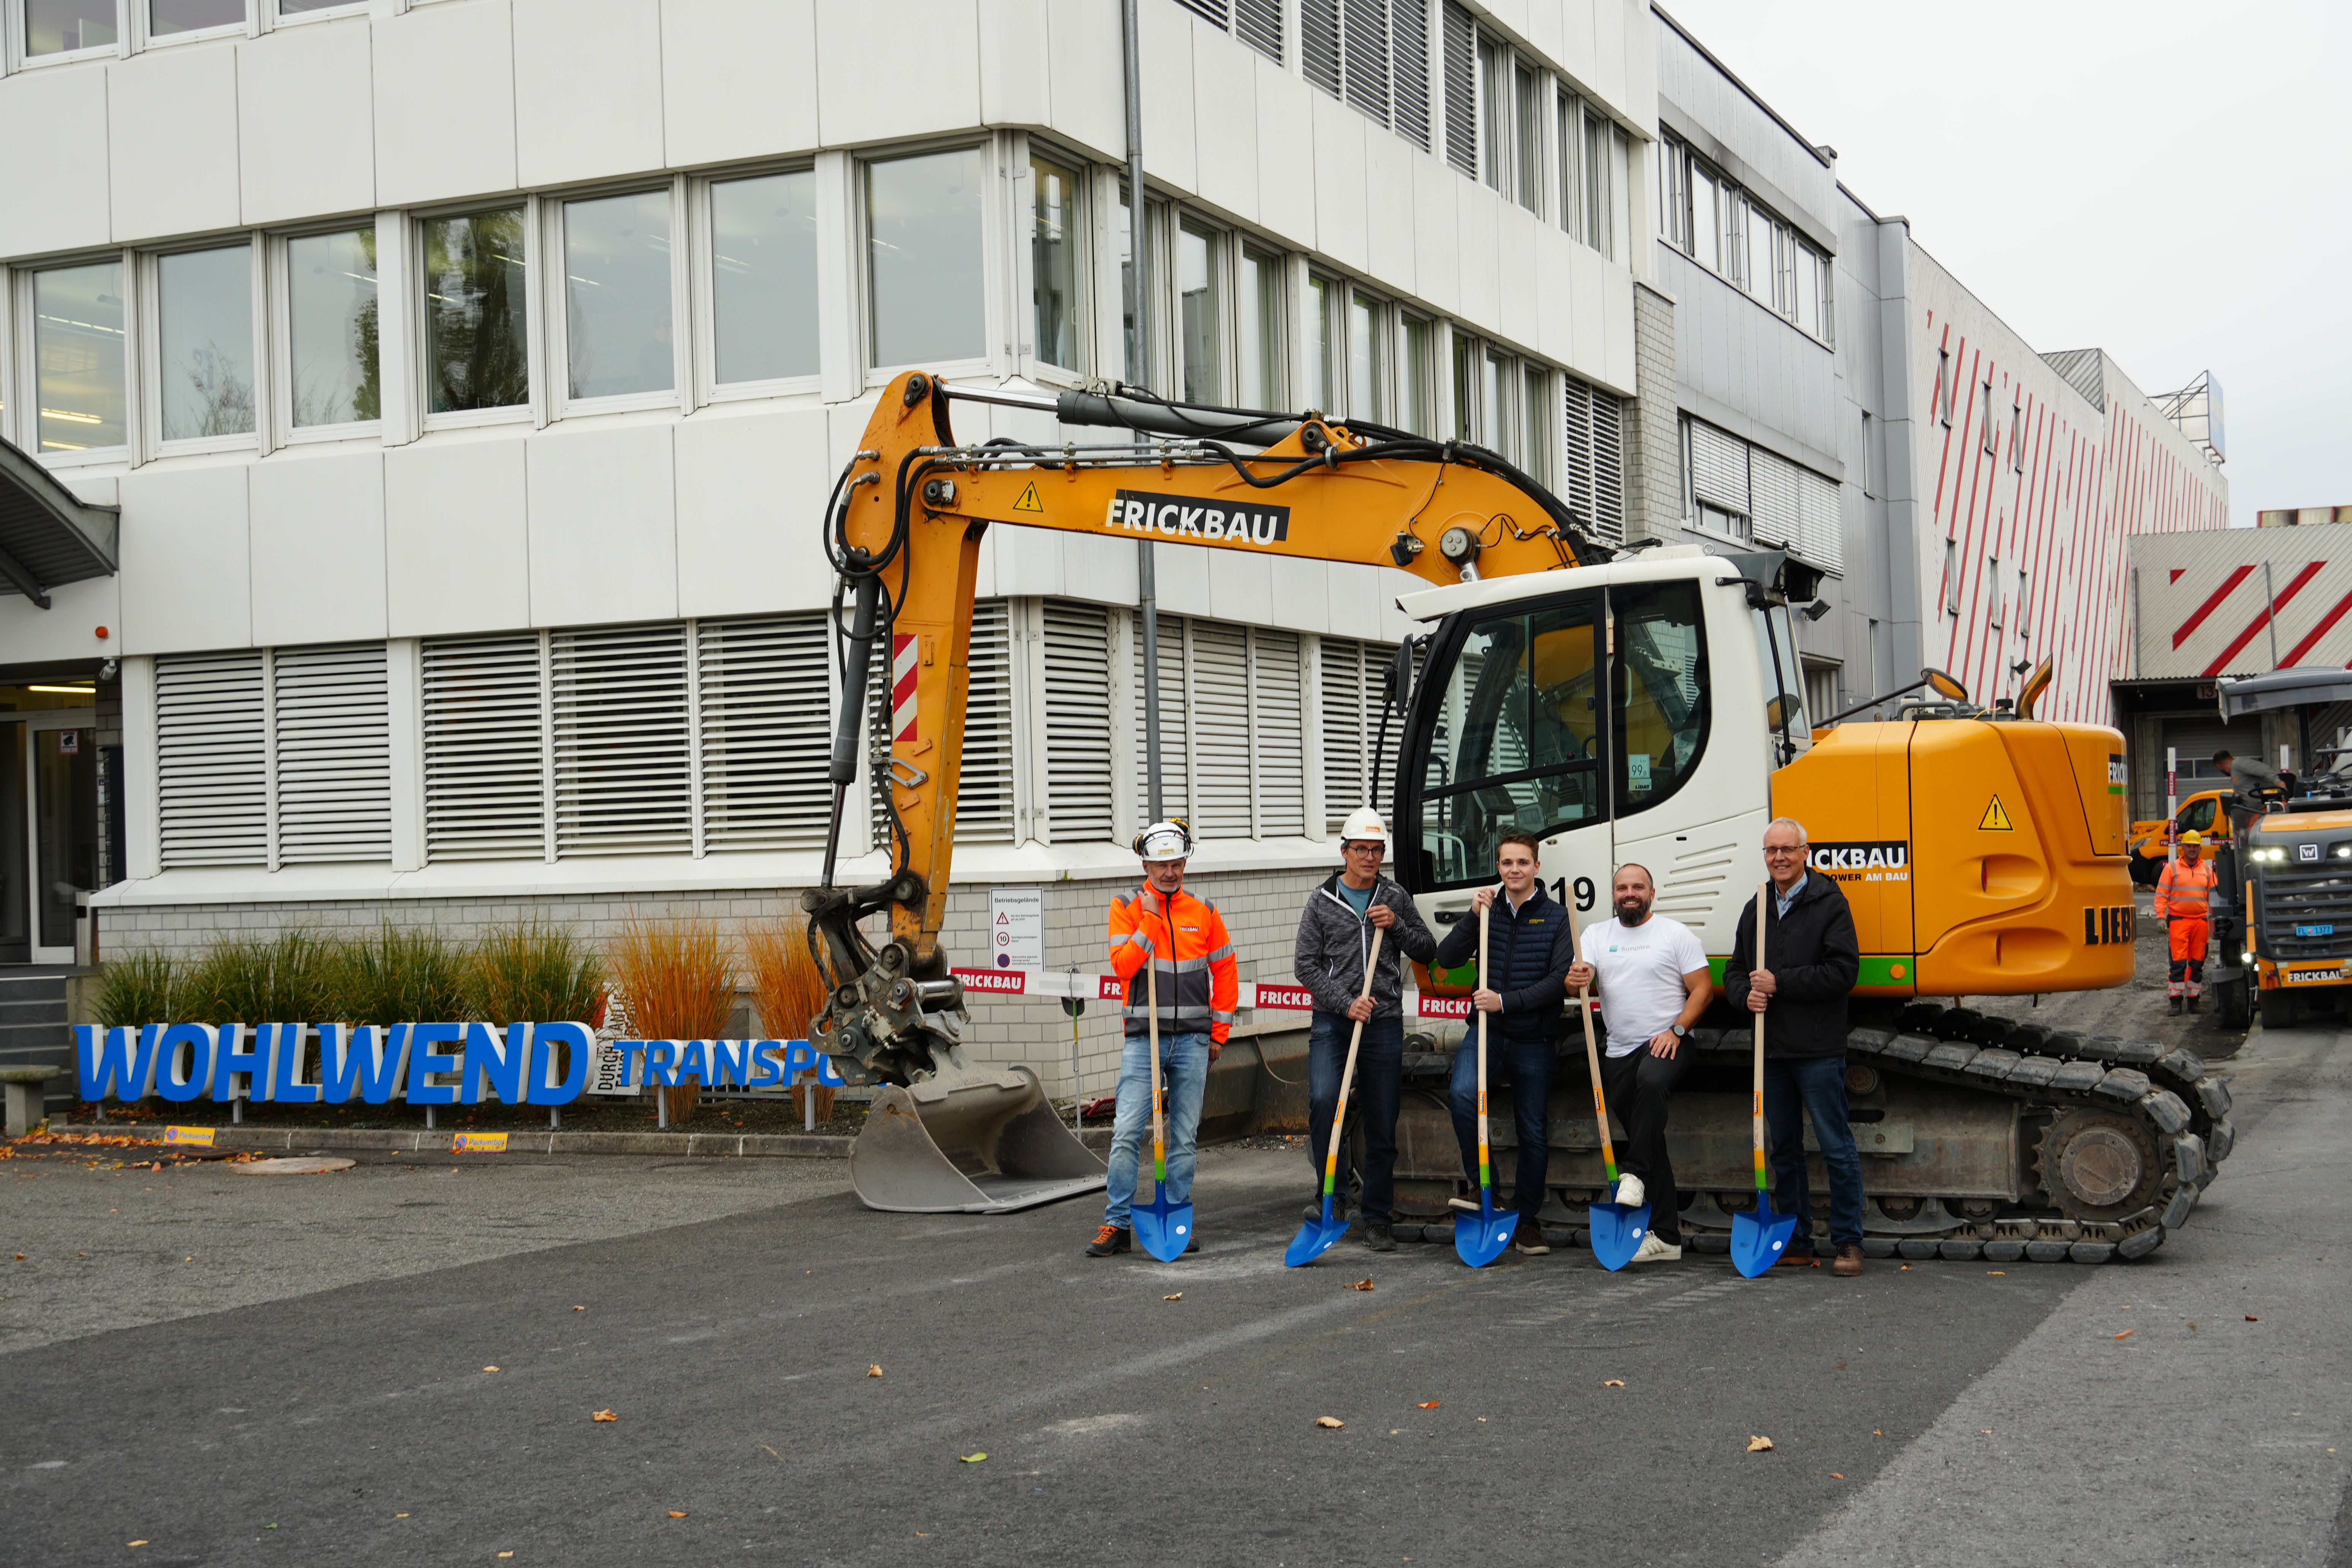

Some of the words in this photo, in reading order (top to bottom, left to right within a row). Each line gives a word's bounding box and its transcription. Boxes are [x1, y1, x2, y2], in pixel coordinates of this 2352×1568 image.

[1105, 498, 1277, 545] FRICKBAU
[2200, 686, 2214, 697] 13
[1632, 764, 1642, 776] 99
[1807, 847, 1905, 870] ICKBAU
[1885, 872, 1908, 881] BAU
[2083, 905, 2136, 945] LIEBH
[1260, 991, 1313, 1006] FRICKB
[1423, 999, 1472, 1014] FRICK
[74, 1022, 596, 1106] WOHLWEND
[614, 1039, 846, 1087] TRANSPO
[179, 1131, 212, 1140] Parkverbot
